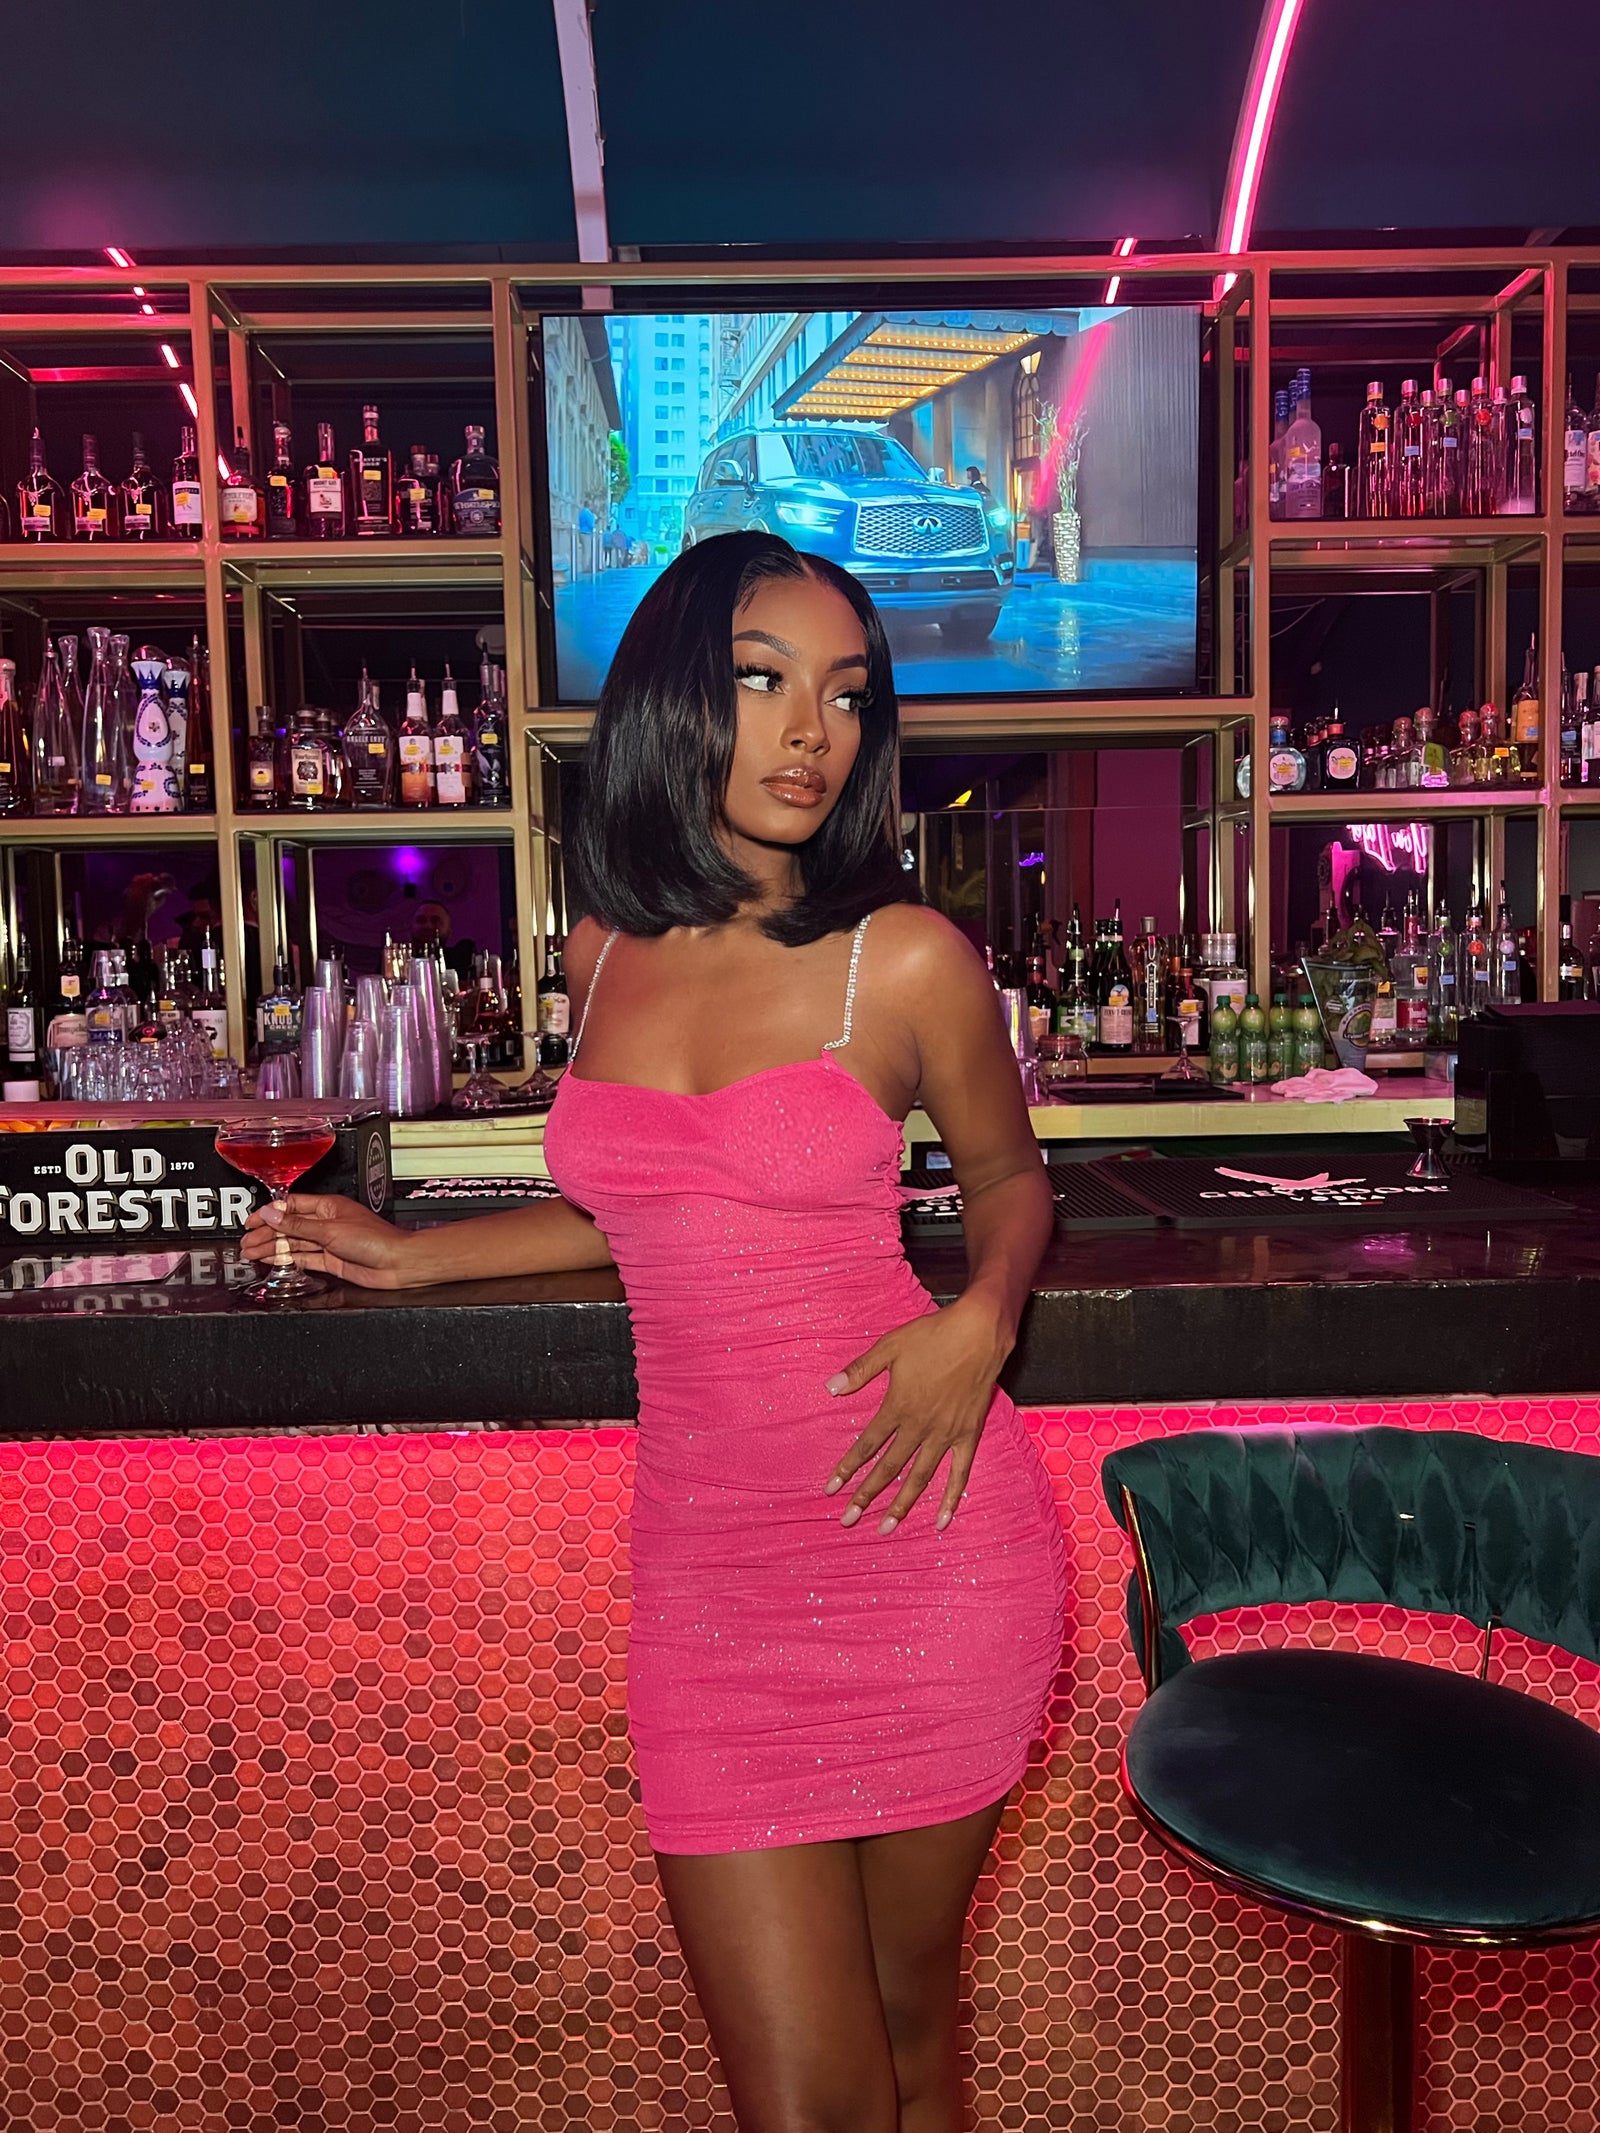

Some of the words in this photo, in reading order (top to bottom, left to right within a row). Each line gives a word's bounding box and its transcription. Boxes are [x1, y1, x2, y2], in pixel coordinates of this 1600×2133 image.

[264, 1012, 293, 1025] KNOB
[33, 1165, 62, 1175] ESTD
[65, 1143, 167, 1185] OLD
[170, 1161, 195, 1171] 1870
[1199, 1187, 1295, 1199] GREY
[1311, 1185, 1449, 1196] GOOSE
[0, 1185, 256, 1235] ORESTER
